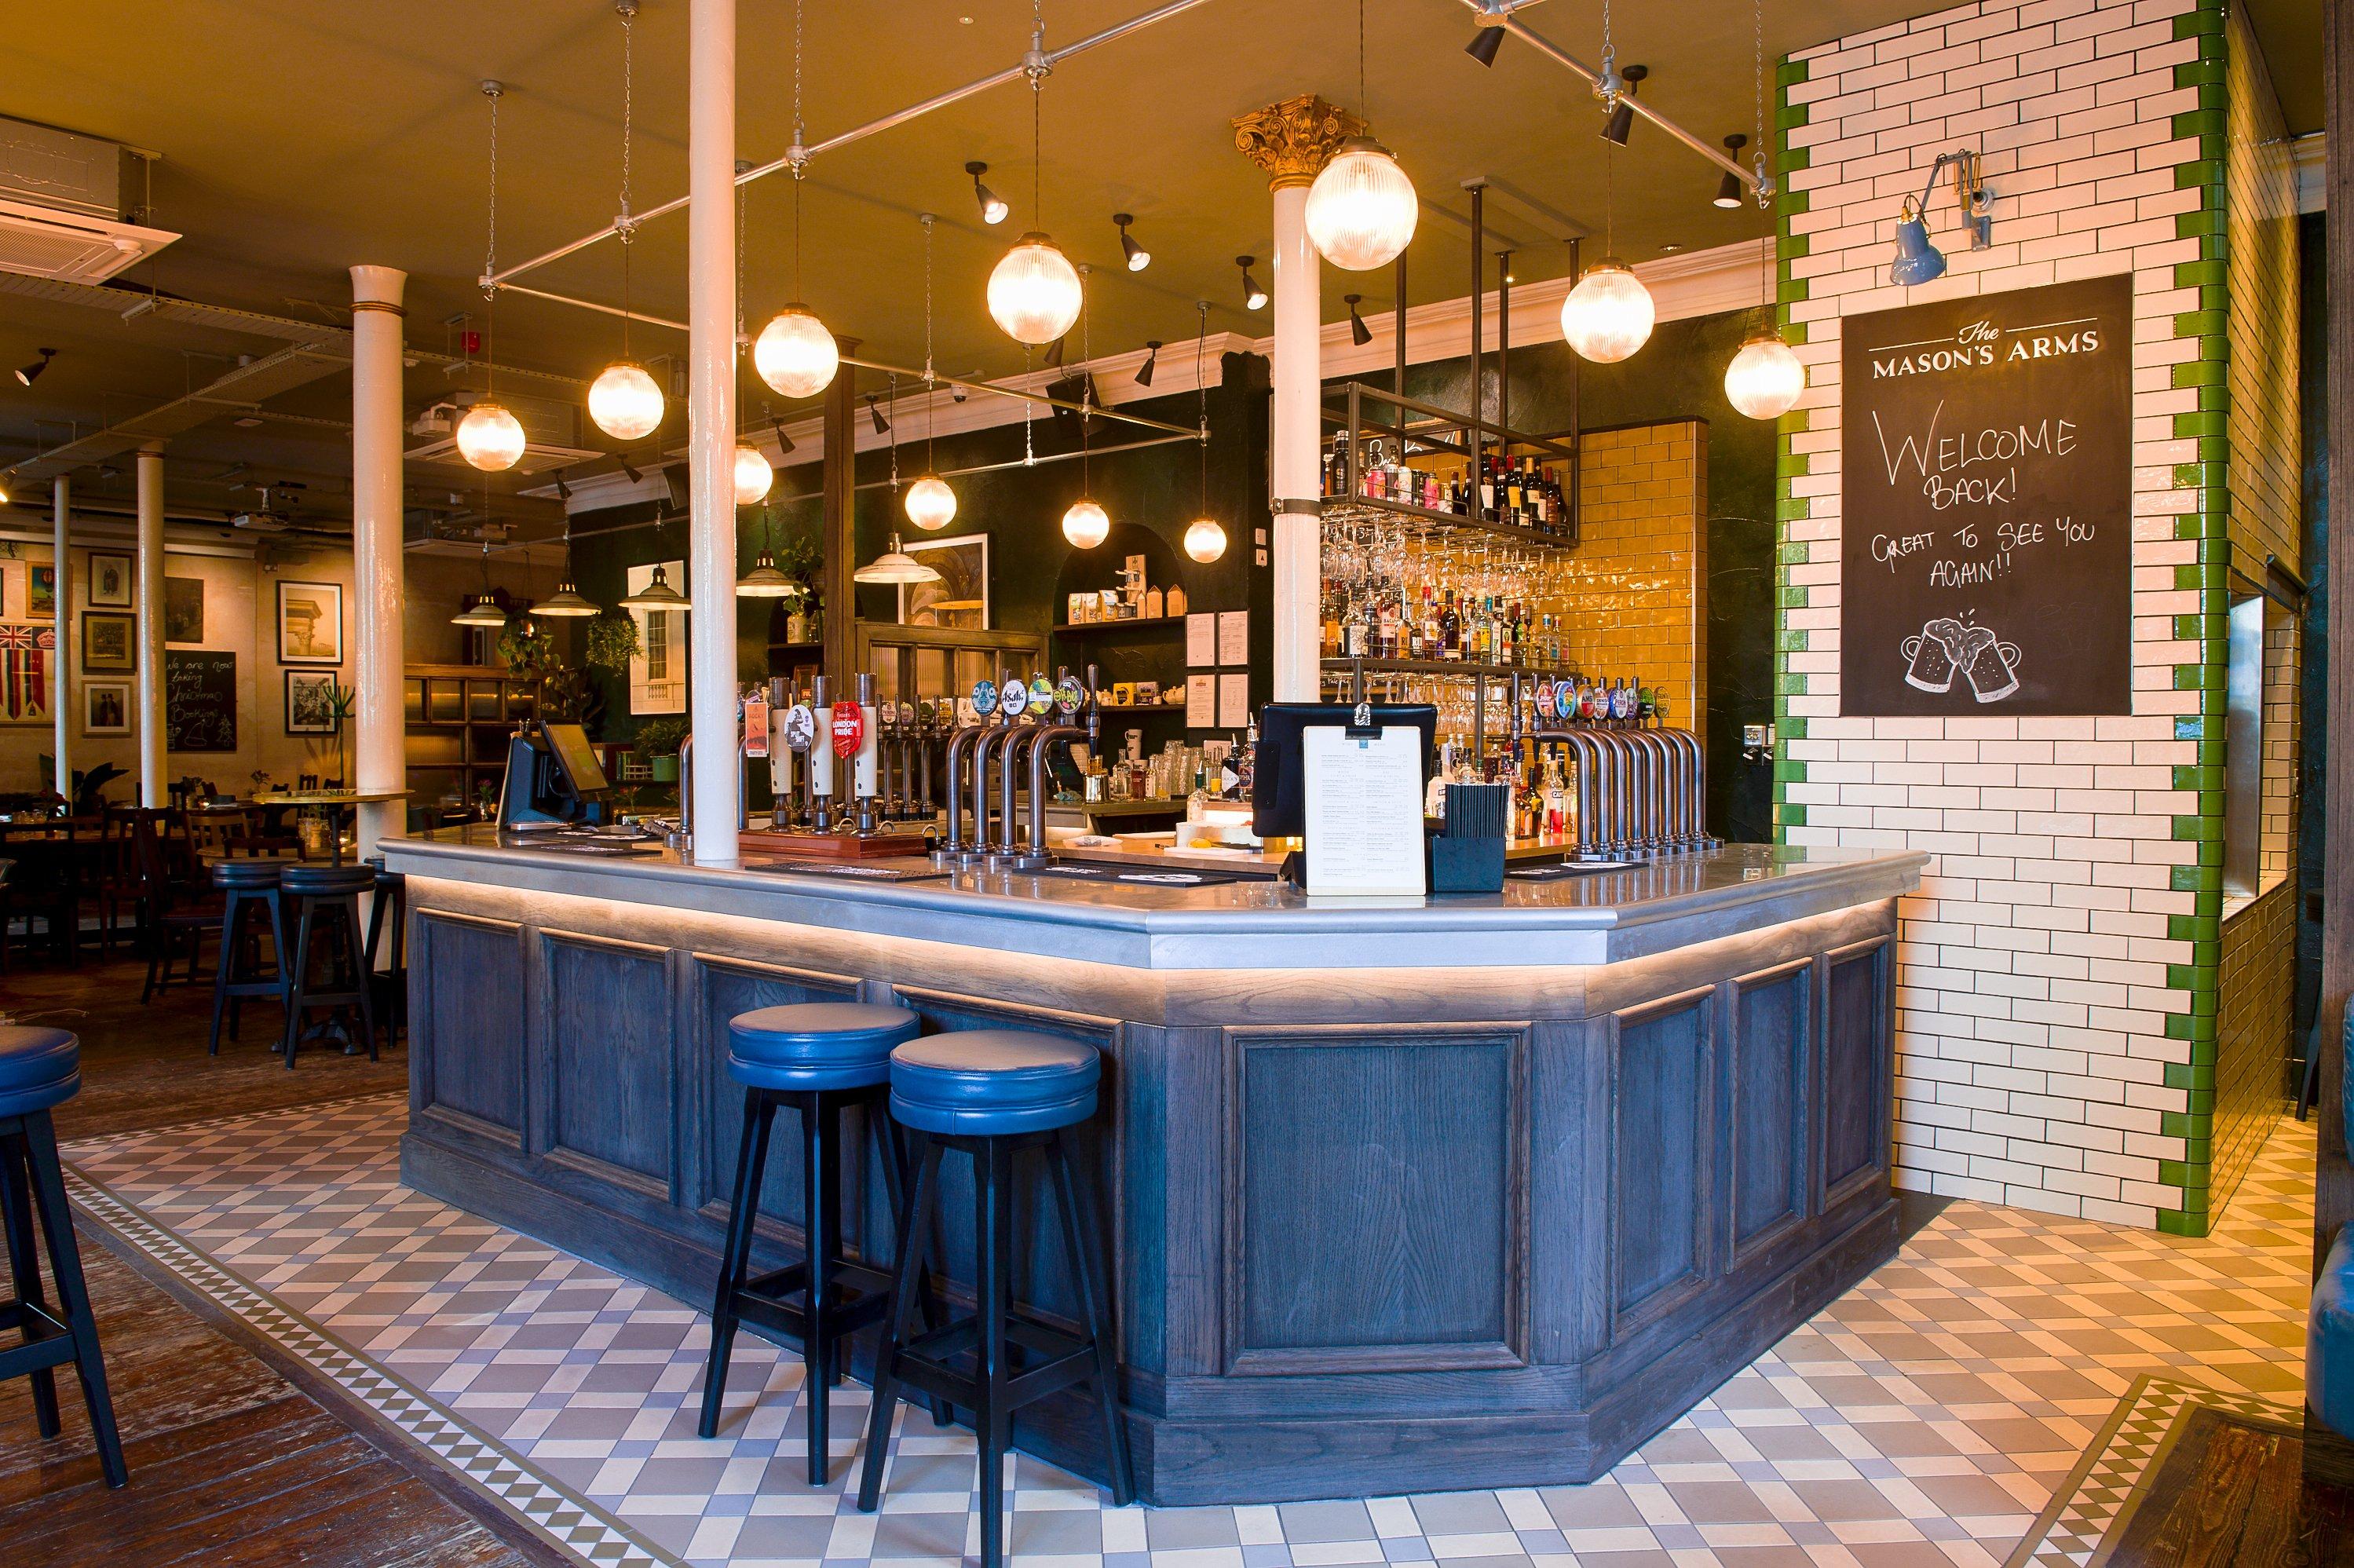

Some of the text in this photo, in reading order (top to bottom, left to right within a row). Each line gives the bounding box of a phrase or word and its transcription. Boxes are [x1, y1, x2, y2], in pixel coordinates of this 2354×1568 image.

[1957, 320, 2000, 345] The
[1872, 331, 2100, 379] MASON'S ARMS
[1924, 467, 2016, 510] BACK!
[1871, 532, 1935, 574] GREAT
[1997, 522, 2044, 551] SEE
[2055, 516, 2096, 547] YOU
[1929, 553, 2012, 589] AGAIN!!
[832, 720, 857, 729] LONDON
